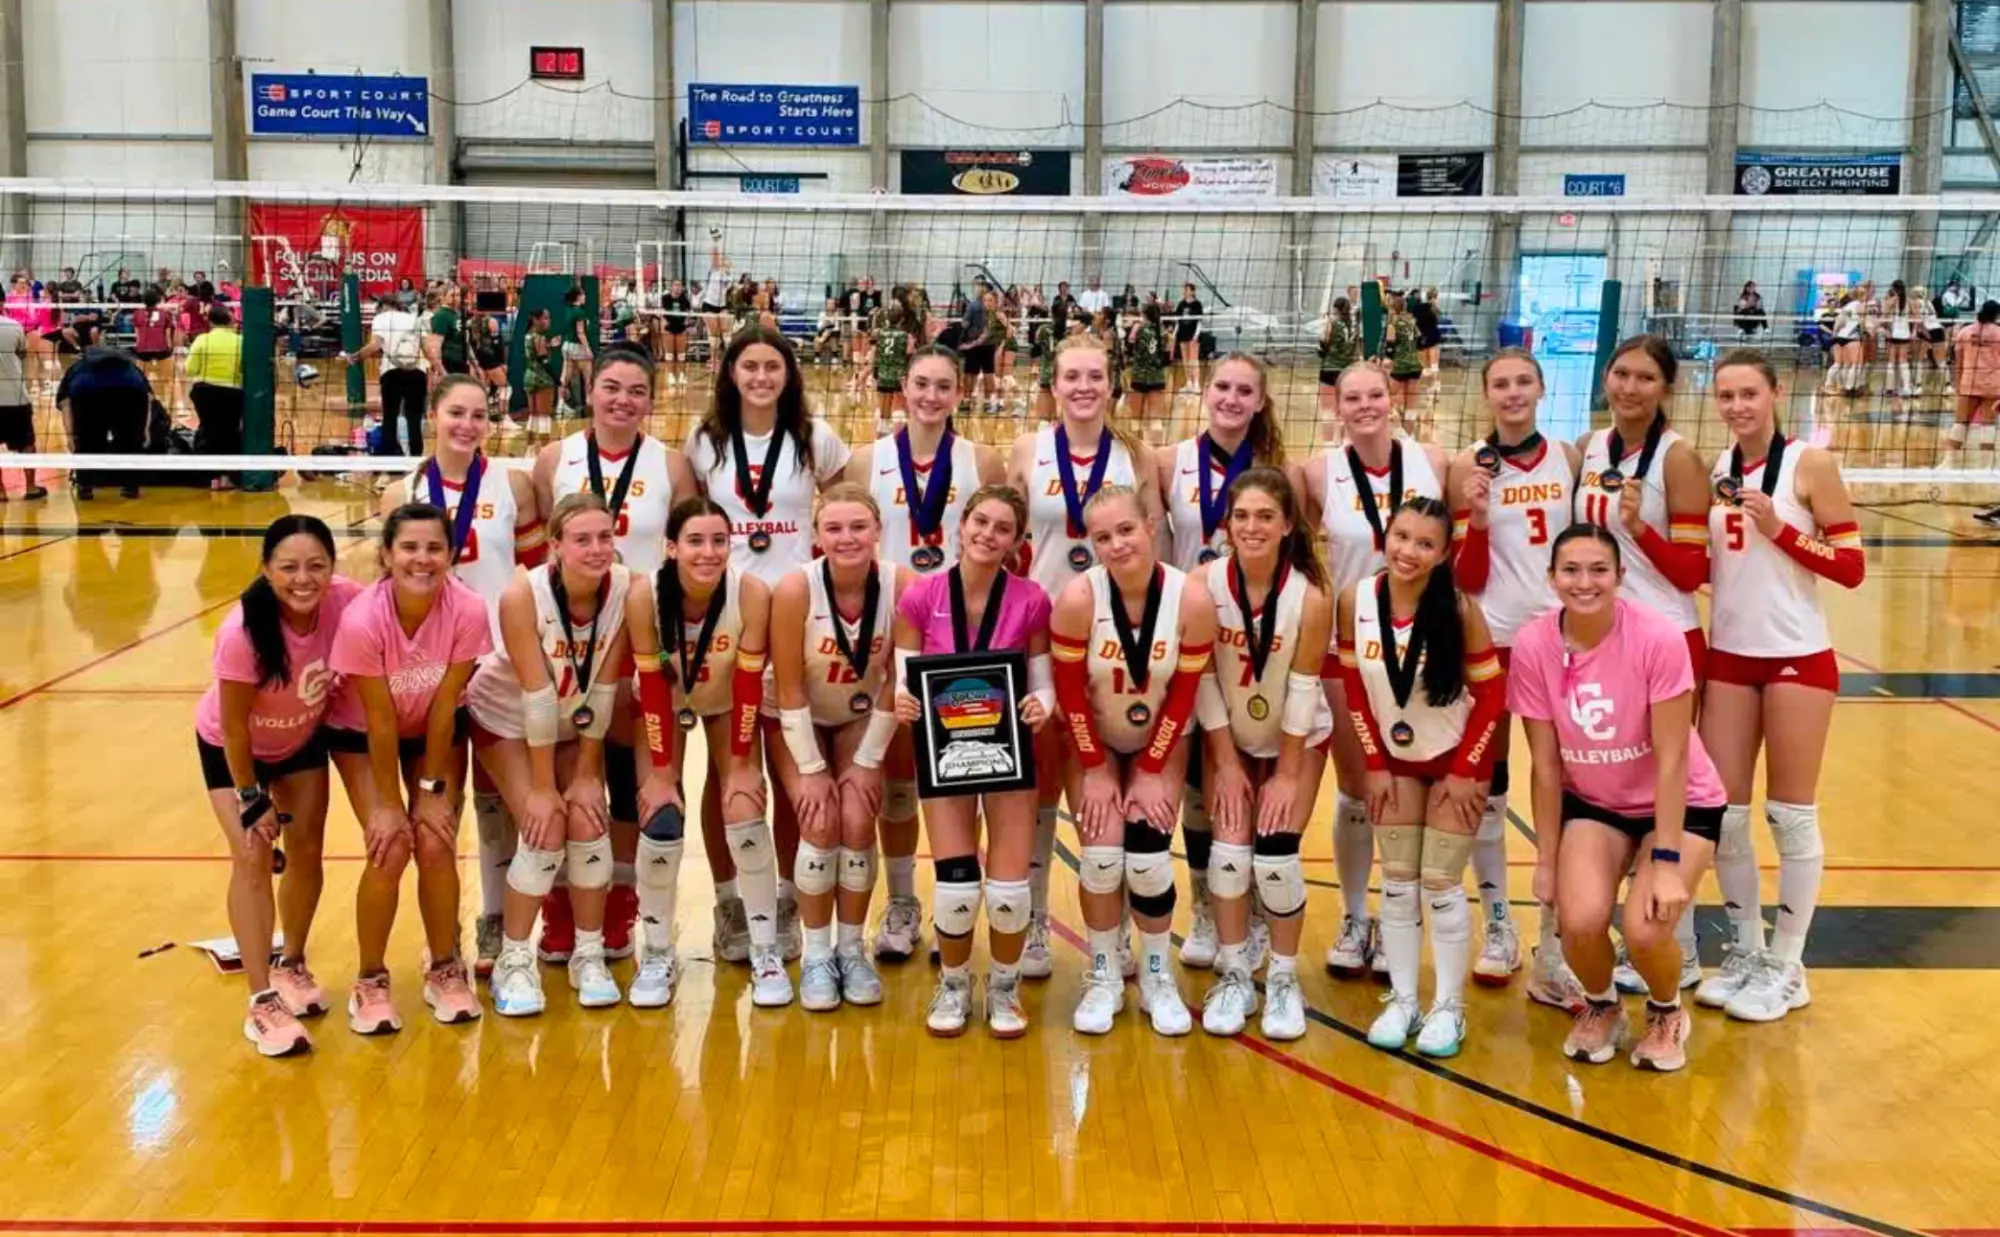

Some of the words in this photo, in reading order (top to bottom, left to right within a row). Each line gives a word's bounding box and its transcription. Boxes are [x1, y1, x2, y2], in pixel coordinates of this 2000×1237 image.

[289, 88, 353, 99] SPORT
[693, 88, 717, 102] The
[721, 89, 756, 102] Road
[758, 90, 773, 102] to
[777, 90, 844, 104] Greatness
[257, 104, 297, 117] Game
[301, 106, 340, 118] Court
[344, 106, 372, 120] This
[375, 107, 406, 122] Way
[779, 104, 817, 117] Starts
[821, 105, 854, 117] Here
[726, 125, 787, 136] SPORT
[794, 126, 855, 136] COURT
[1774, 167, 1890, 178] GREATHOUSE
[1774, 179, 1827, 187] SCREEN
[1830, 179, 1890, 188] PRINTING
[1567, 180, 1606, 194] COURT
[370, 251, 397, 266] ON
[350, 268, 393, 282] EDIA
[1501, 482, 1563, 506] DONS
[1526, 507, 1549, 545] 3
[1726, 513, 1744, 551] 5
[1794, 530, 1837, 560] DONS
[1217, 625, 1283, 653] DOS
[644, 711, 664, 754] DONS
[739, 703, 758, 744] DONS
[1068, 711, 1097, 754] DONS
[1350, 709, 1379, 756] DONS
[1148, 715, 1178, 760] DONS
[1561, 741, 1652, 765] OLLEYBALL
